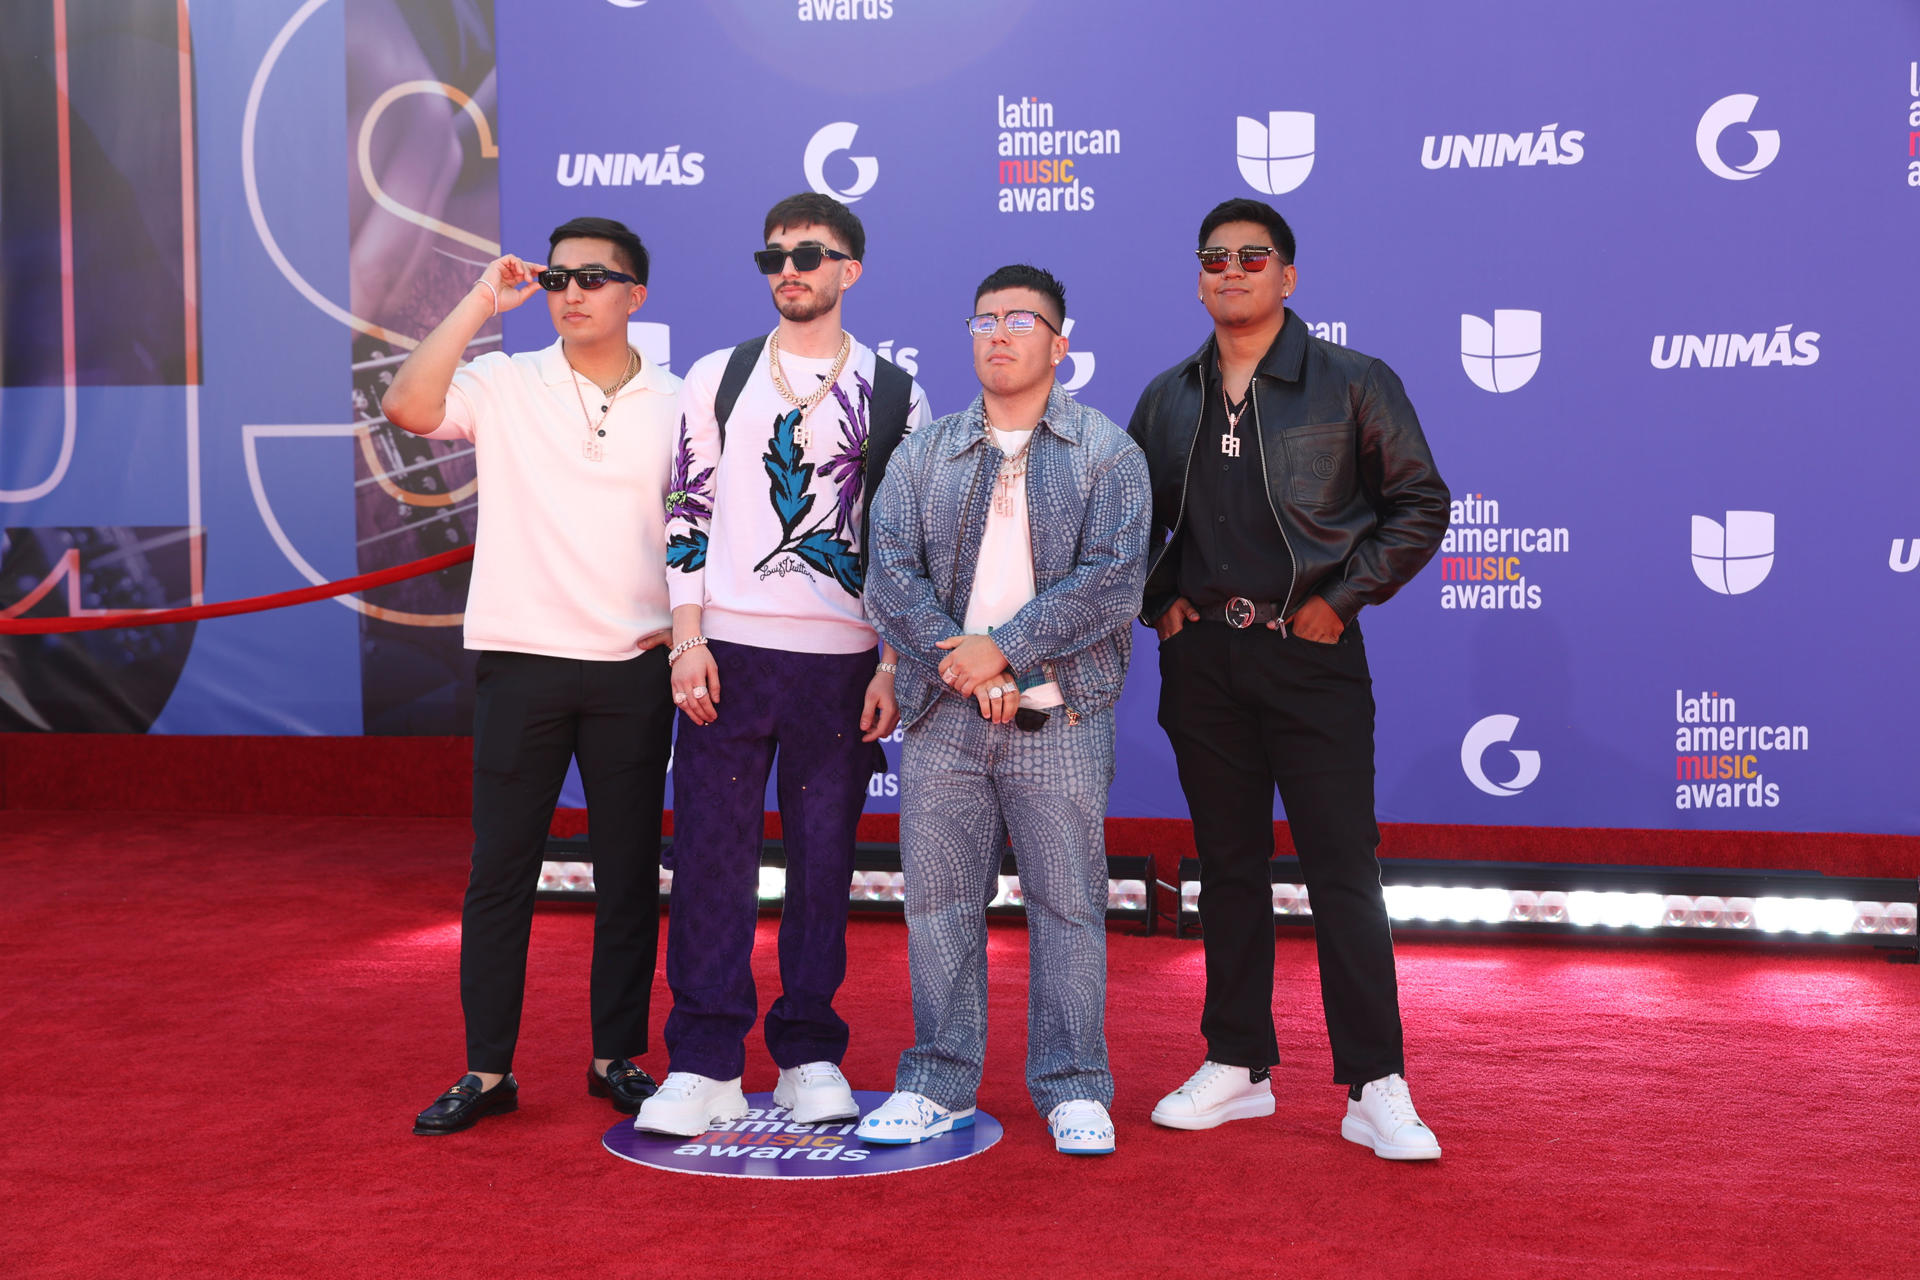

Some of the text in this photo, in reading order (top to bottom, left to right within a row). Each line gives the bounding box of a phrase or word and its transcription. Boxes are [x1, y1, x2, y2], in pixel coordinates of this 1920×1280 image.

[998, 95, 1054, 128] latin
[998, 129, 1121, 157] american
[1420, 122, 1586, 170] UNIMÁS
[556, 145, 705, 187] UNIMÁS
[999, 158, 1075, 185] music
[998, 178, 1095, 213] awards
[1650, 323, 1821, 370] UNIMÁS
[1450, 492, 1499, 525] atin
[1440, 527, 1569, 553] american
[1441, 556, 1521, 581] music
[1440, 576, 1542, 610] awards
[1676, 690, 1736, 724] latin
[1675, 725, 1809, 752] american
[1676, 754, 1758, 781] music
[1675, 774, 1780, 810] awards
[673, 1144, 871, 1162] awards
[688, 1132, 843, 1148] music
